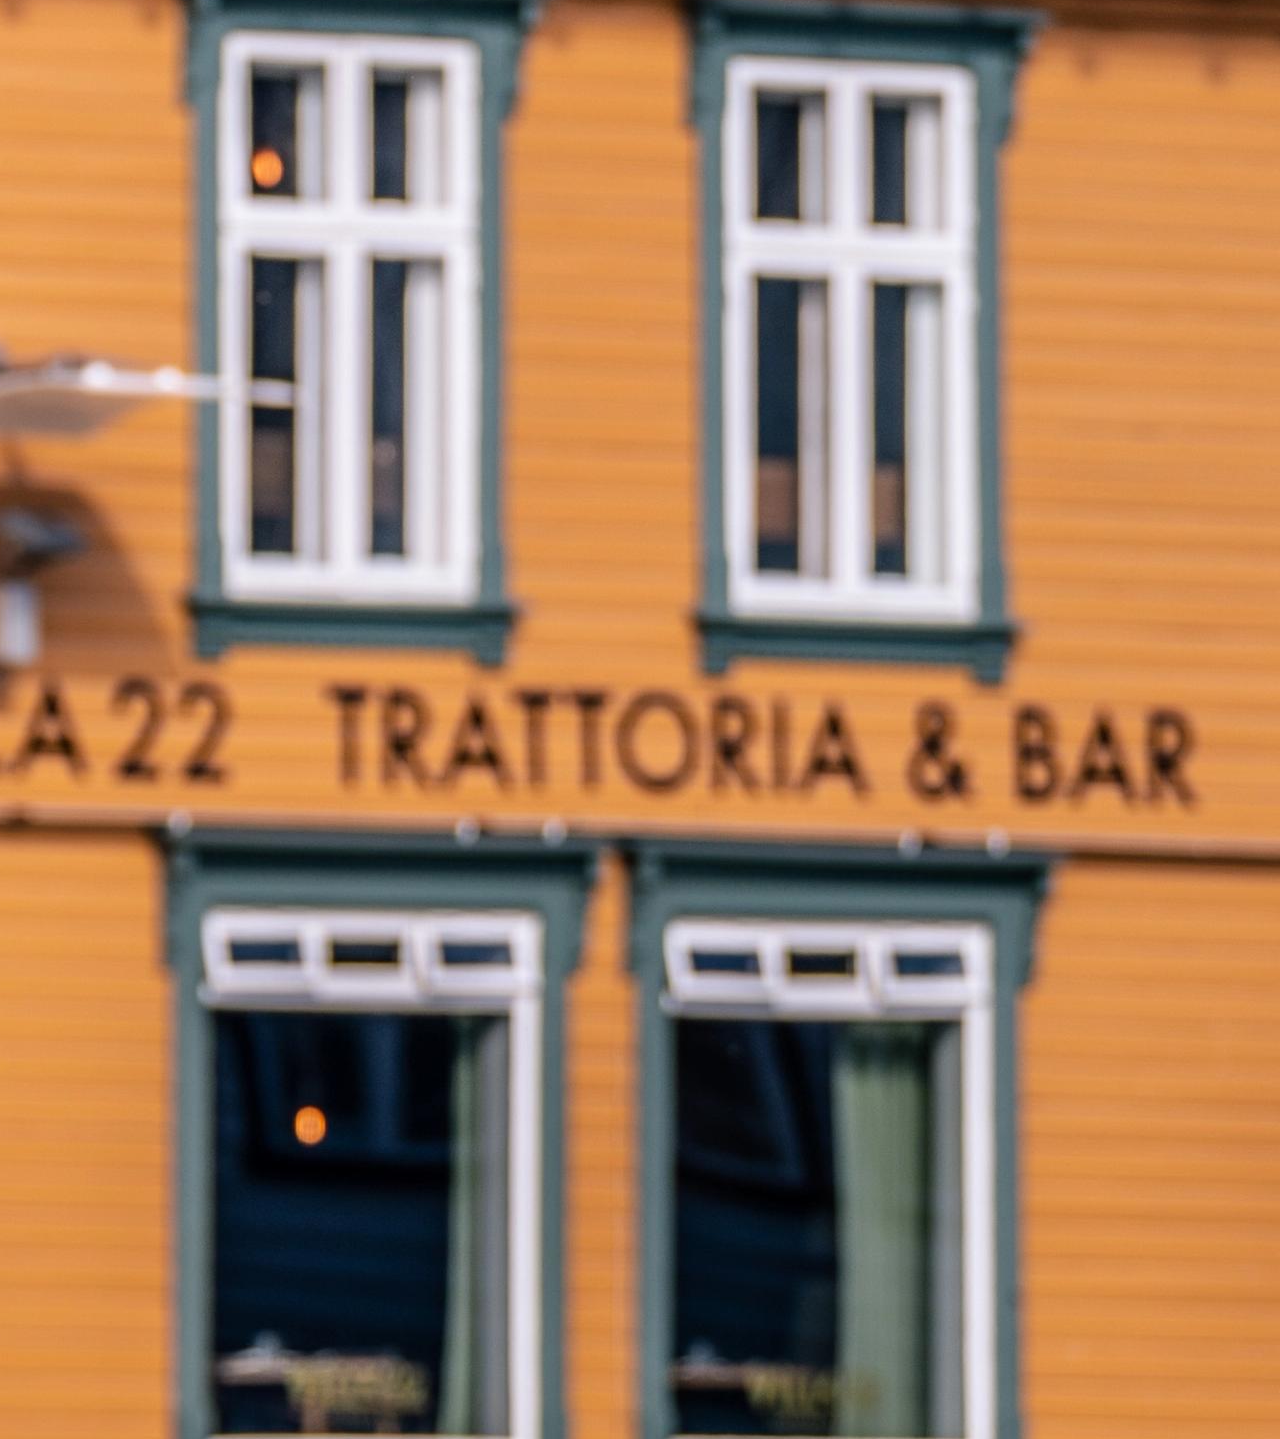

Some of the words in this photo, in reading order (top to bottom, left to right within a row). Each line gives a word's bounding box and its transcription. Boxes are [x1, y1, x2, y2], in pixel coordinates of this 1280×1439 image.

[326, 683, 873, 799] TRATTORIA
[906, 699, 977, 803] &
[1010, 703, 1200, 808] BAR
